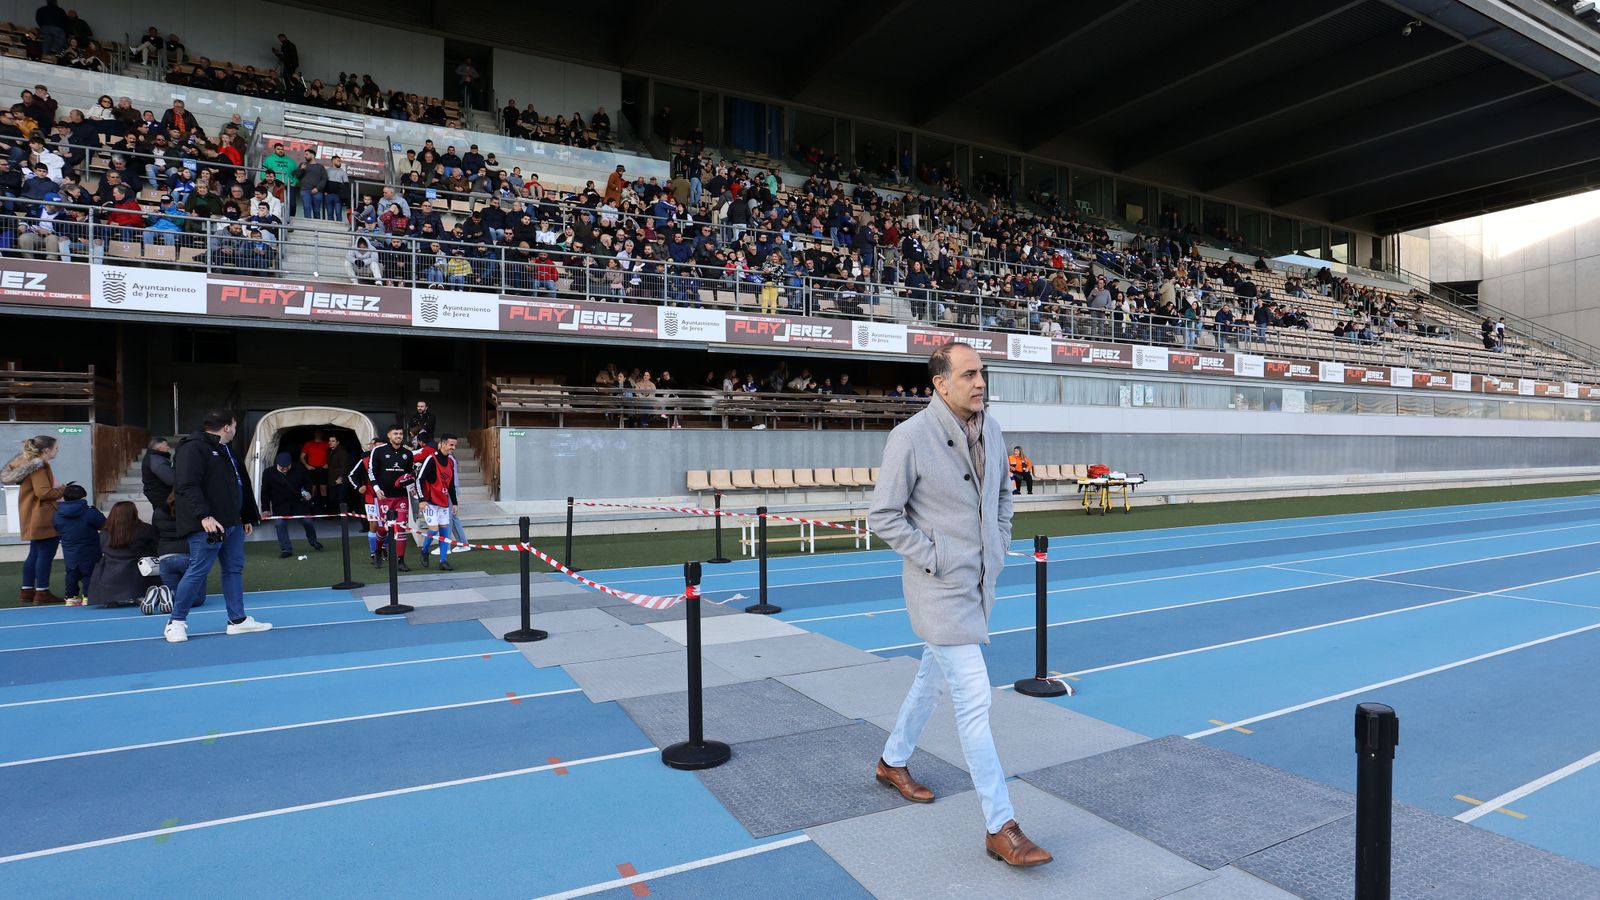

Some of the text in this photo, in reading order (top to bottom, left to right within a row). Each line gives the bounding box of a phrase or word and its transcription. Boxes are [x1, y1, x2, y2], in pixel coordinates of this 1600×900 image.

[0, 270, 48, 290] EZ
[132, 283, 196, 294] Ayuntamiento
[442, 304, 491, 313] Ayuntamiento
[426, 508, 434, 517] 10
